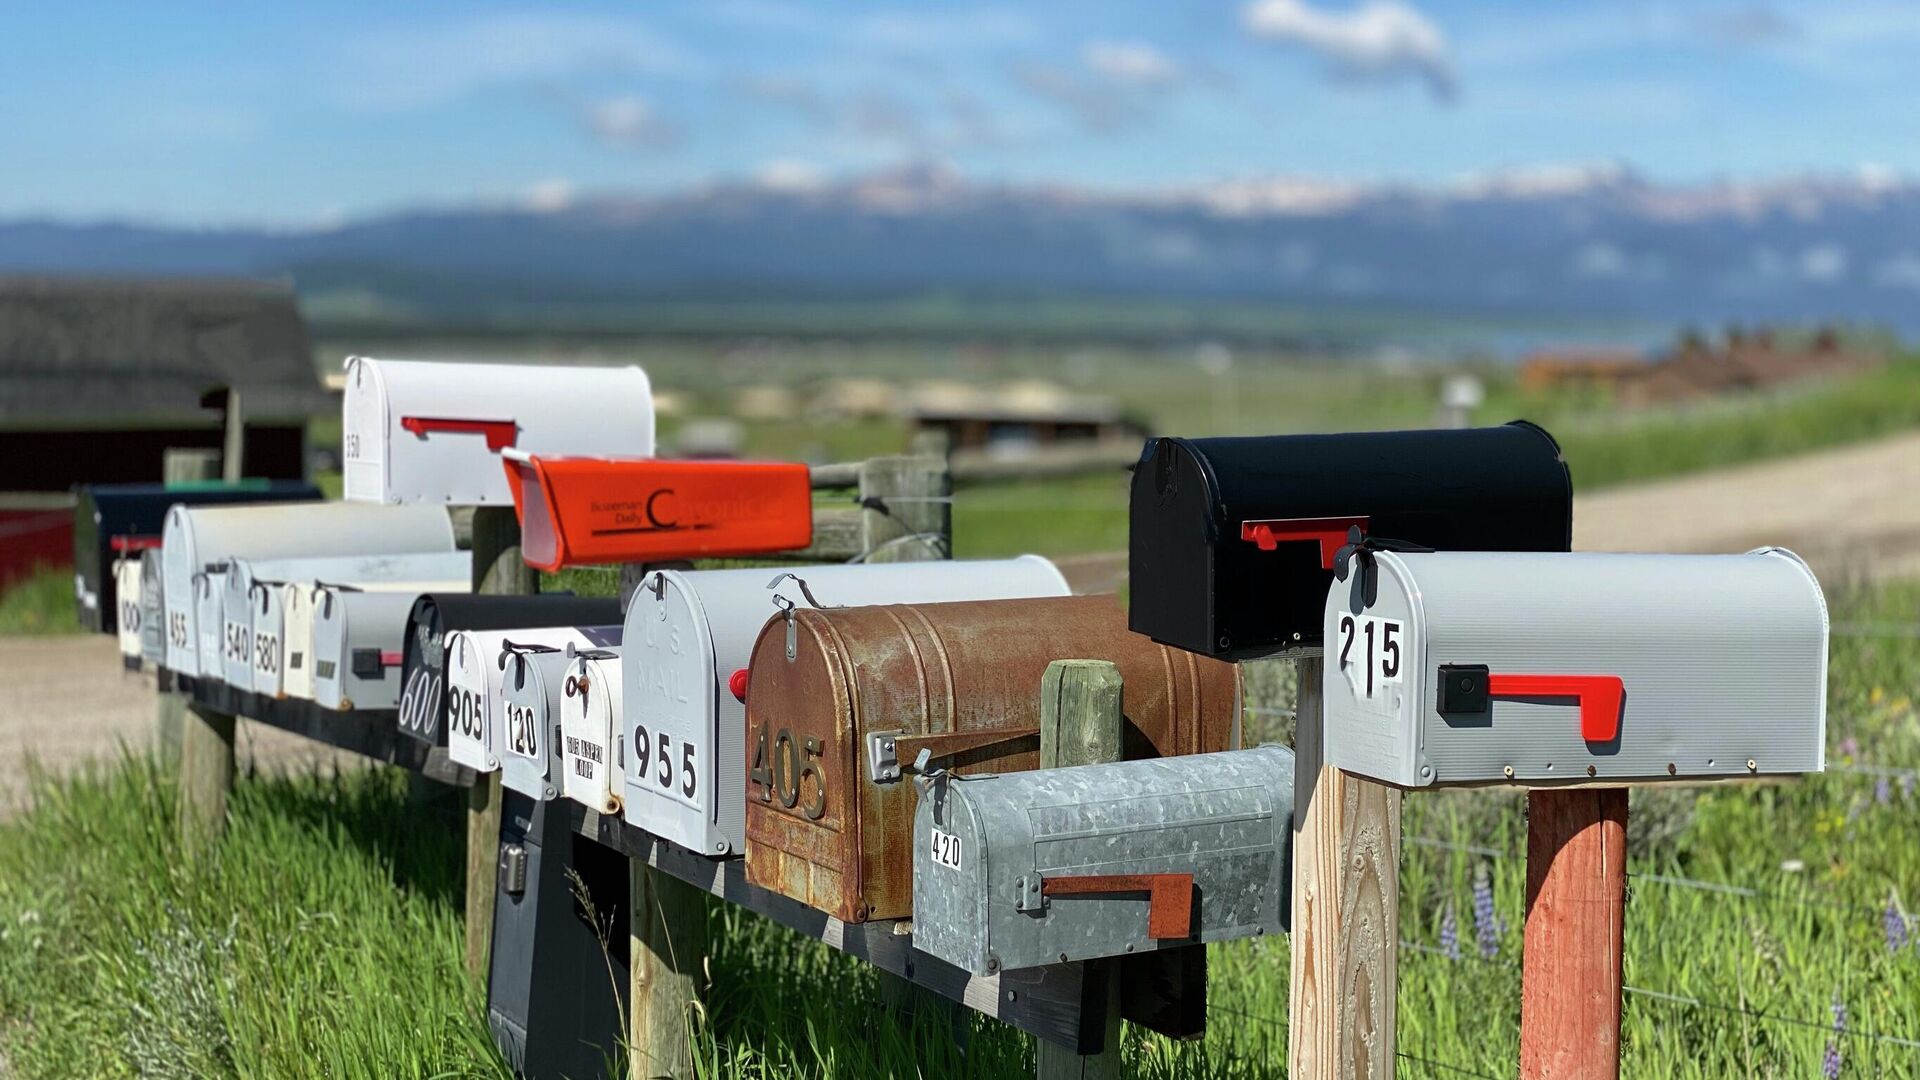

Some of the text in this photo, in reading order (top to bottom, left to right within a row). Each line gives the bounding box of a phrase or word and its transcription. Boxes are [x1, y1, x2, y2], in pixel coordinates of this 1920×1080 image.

[616, 512, 643, 525] Daily
[227, 622, 249, 663] 540
[256, 632, 278, 674] 580
[1340, 615, 1400, 699] 215
[398, 665, 442, 735] 600
[636, 659, 689, 704] MAIL
[448, 684, 483, 741] 905
[507, 702, 537, 756] 120
[574, 757, 594, 779] LOOP
[581, 740, 603, 764] ASPEN
[634, 724, 697, 799] 955
[751, 721, 827, 820] 405
[931, 832, 961, 868] 420
